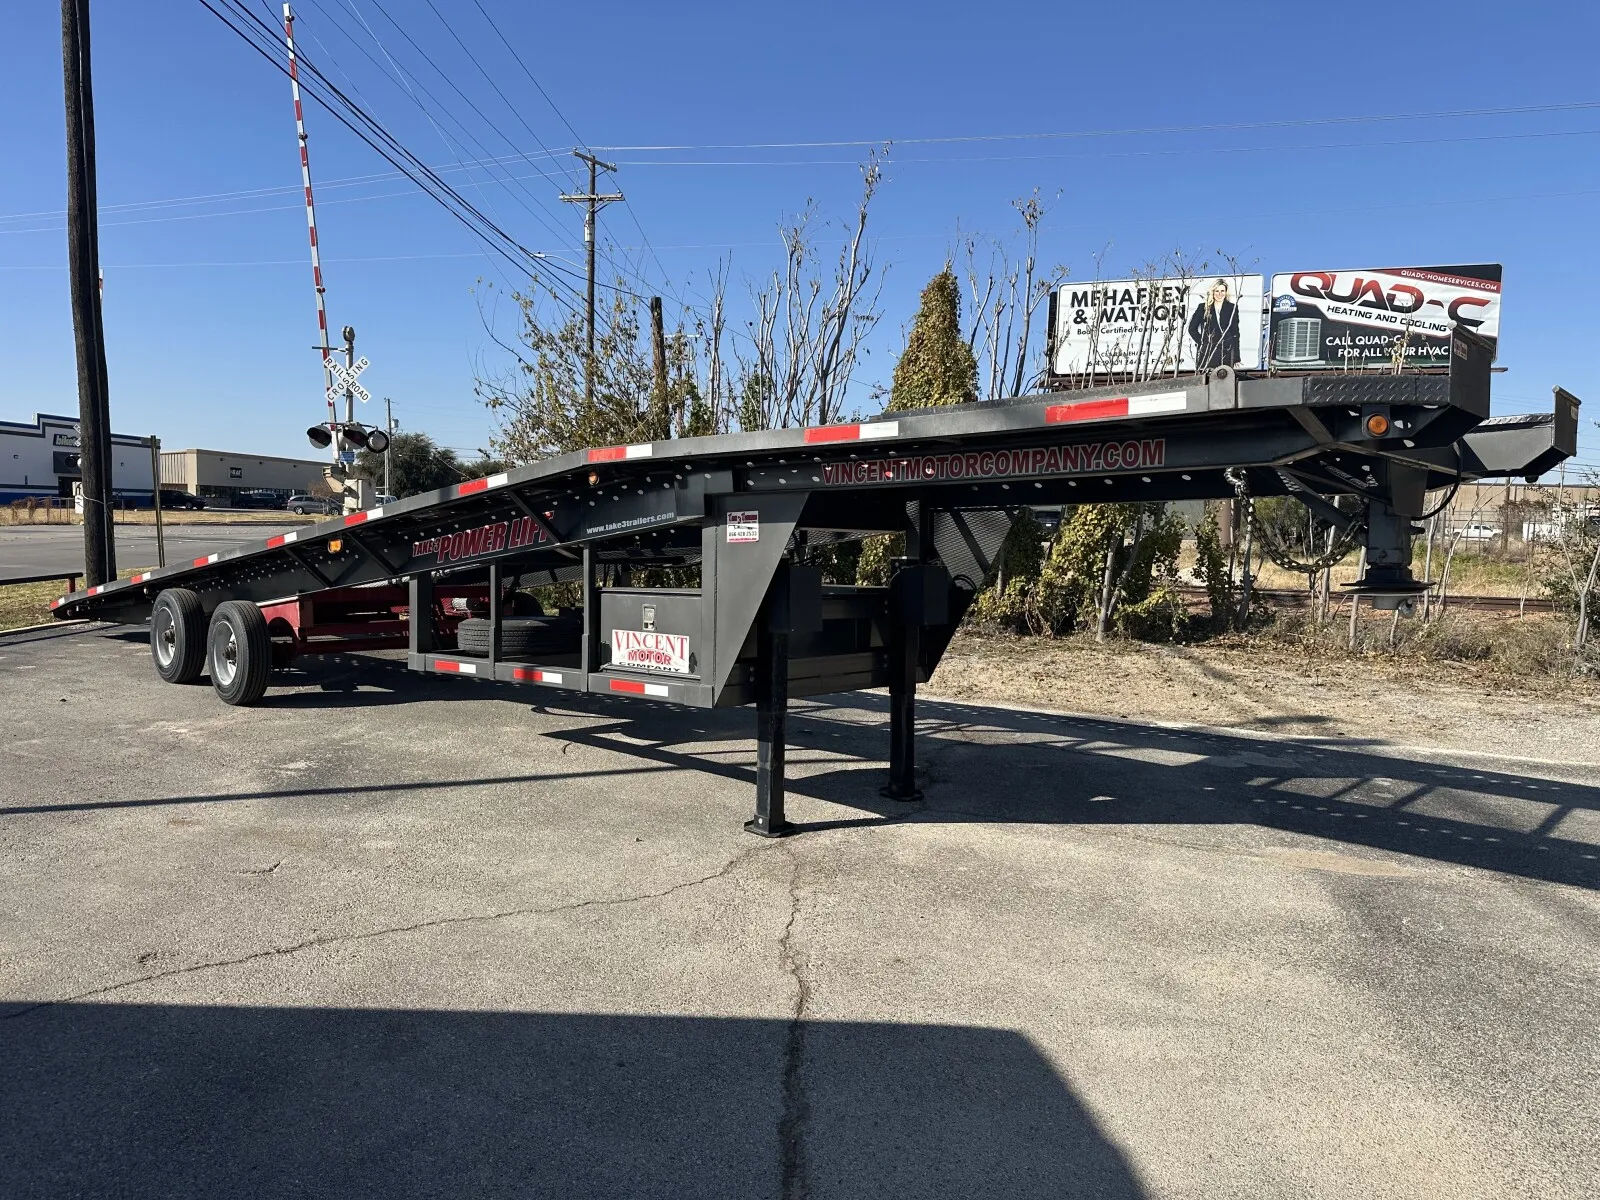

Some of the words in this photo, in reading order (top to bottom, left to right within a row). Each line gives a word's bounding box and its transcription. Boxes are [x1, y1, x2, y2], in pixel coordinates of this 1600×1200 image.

[1401, 270, 1497, 291] QUADC-HOMESERVICES.COM
[1290, 273, 1492, 327] QUAD-C
[1073, 309, 1087, 324] &
[1099, 305, 1186, 323] WATSON
[1327, 305, 1372, 320] HEATING
[1374, 313, 1398, 323] AND
[1399, 318, 1447, 332] COOLING
[1100, 326, 1133, 334] Certified
[1326, 336, 1354, 346] CALL
[1355, 335, 1402, 345] QUAD-C
[1338, 348, 1361, 358] FOR
[1362, 347, 1383, 357] ALL
[1418, 345, 1449, 355] HVAC
[327, 358, 368, 401] CROSSING
[821, 439, 1165, 485] VINCENTMOTORCOMPANY.COM
[586, 511, 675, 535] www.take3trailers.com
[412, 540, 433, 557] TAKE
[437, 521, 509, 563] POWER
[614, 631, 688, 660] VINCENT
[619, 661, 681, 671] COMPANY
[628, 650, 672, 665] MOTOR
